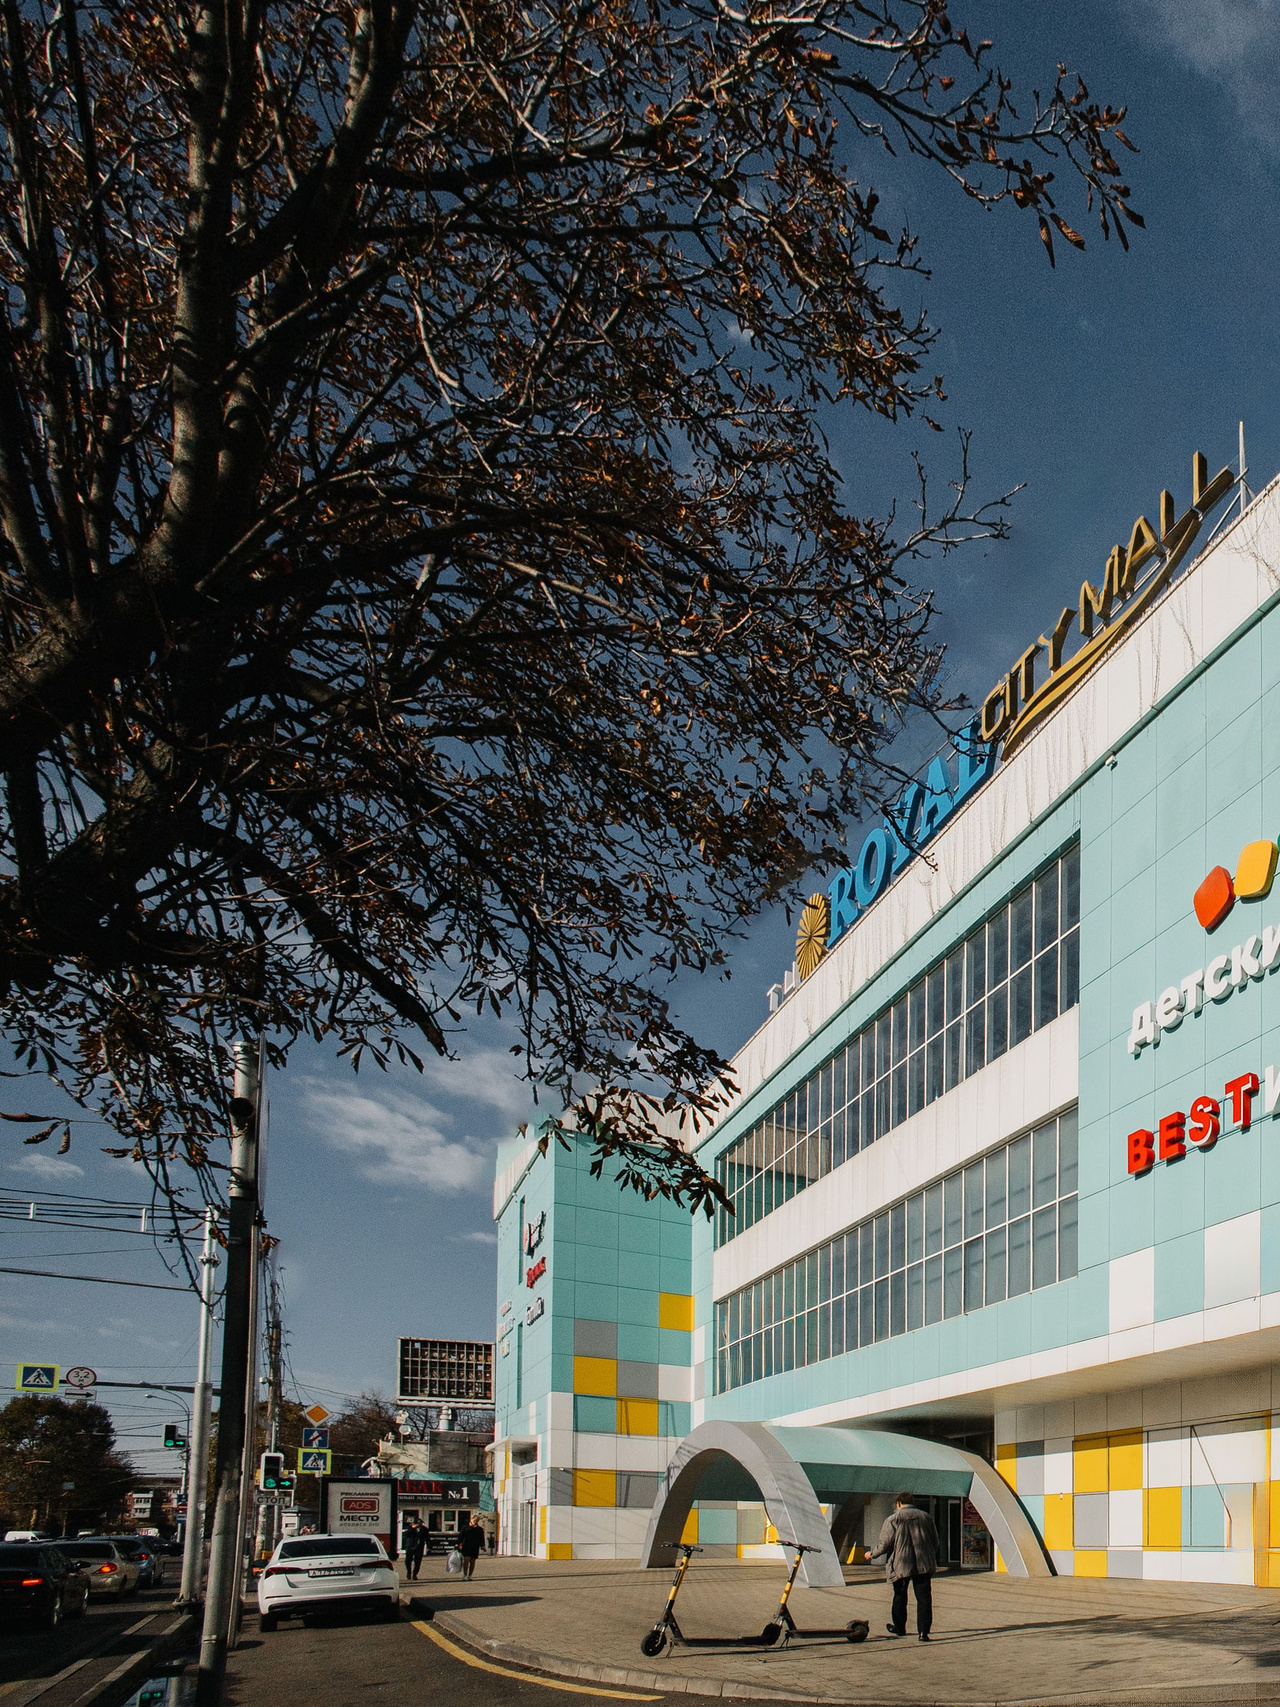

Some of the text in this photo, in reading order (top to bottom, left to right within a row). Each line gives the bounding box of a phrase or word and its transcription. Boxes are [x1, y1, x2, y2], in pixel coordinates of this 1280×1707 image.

[981, 450, 1234, 740] CITY MALL
[827, 712, 998, 949] ROYAL
[397, 1480, 444, 1494] АБАК
